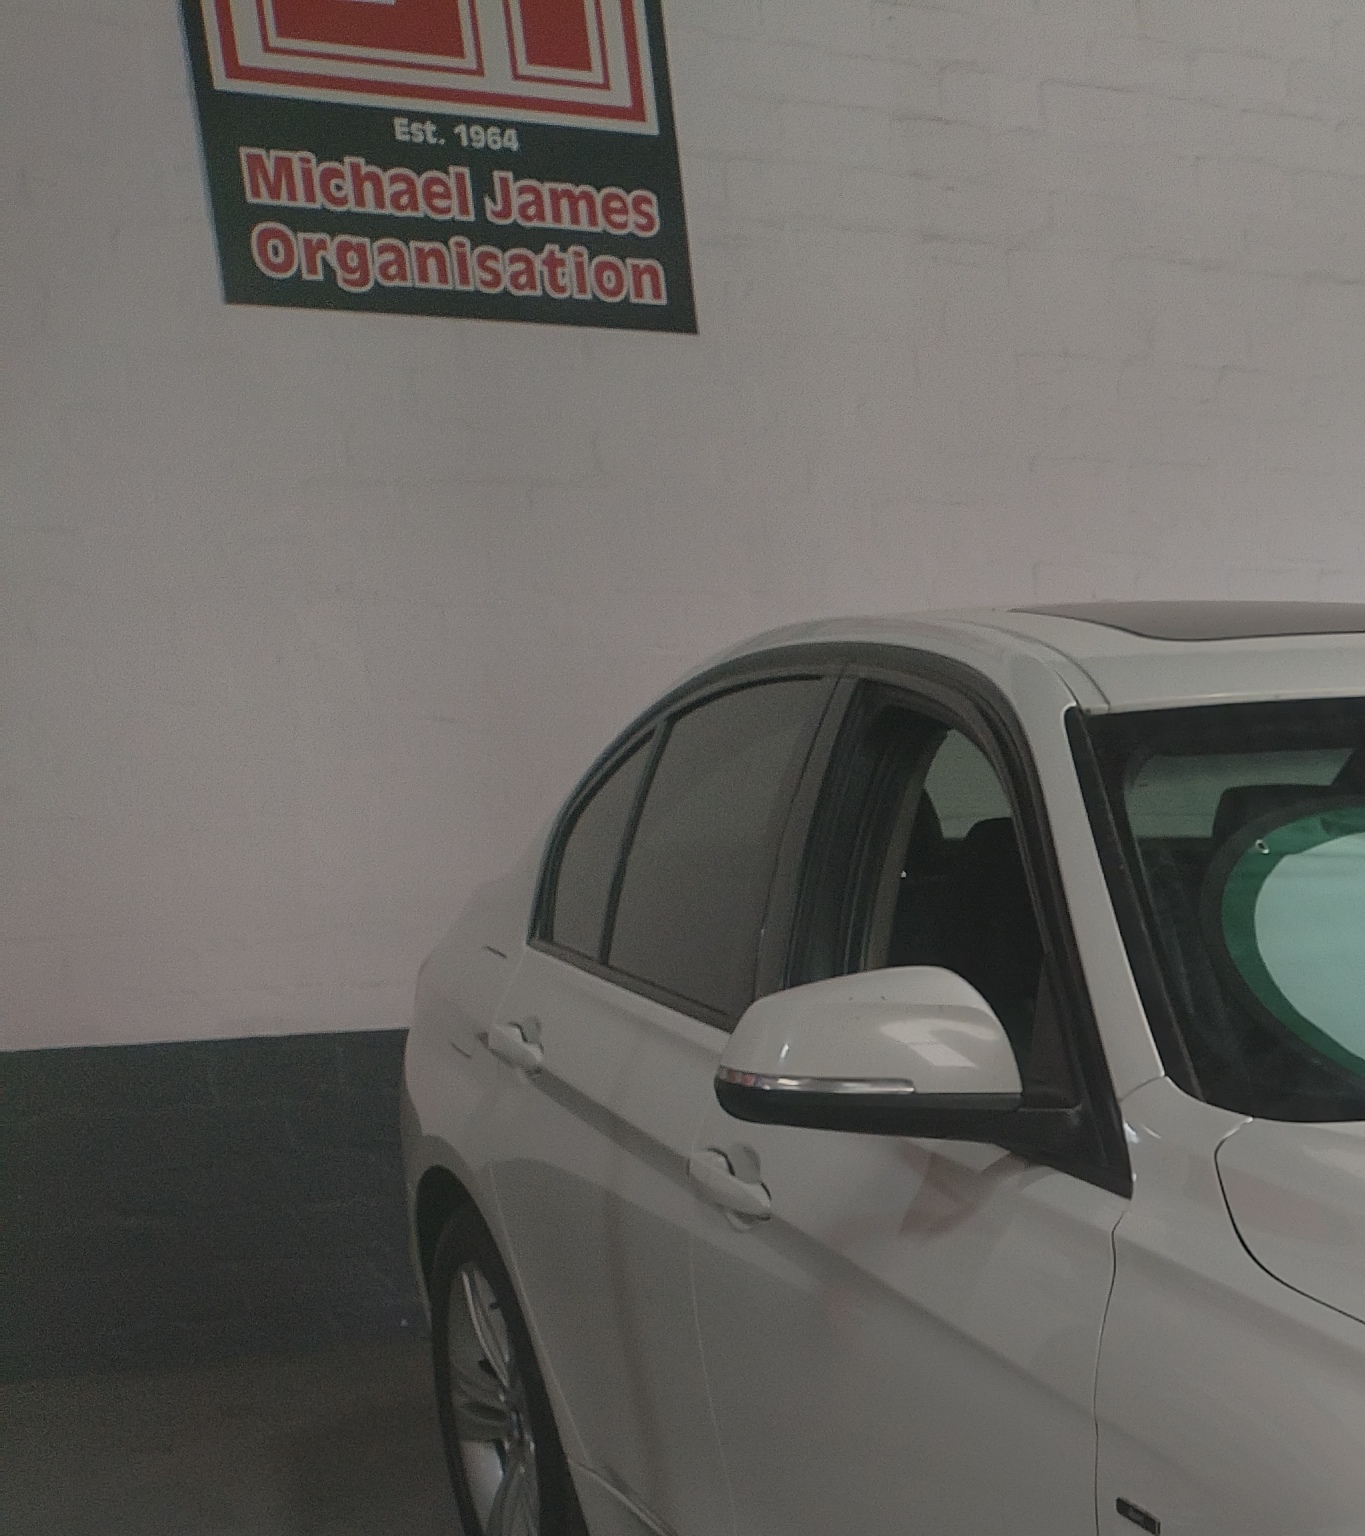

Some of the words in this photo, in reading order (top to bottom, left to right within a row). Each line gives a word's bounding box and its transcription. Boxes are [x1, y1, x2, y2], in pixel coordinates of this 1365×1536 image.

[393, 117, 446, 146] Est.
[454, 124, 520, 151] 1964
[239, 147, 475, 222] Michael
[485, 170, 660, 237] James
[251, 221, 667, 305] Organisation
